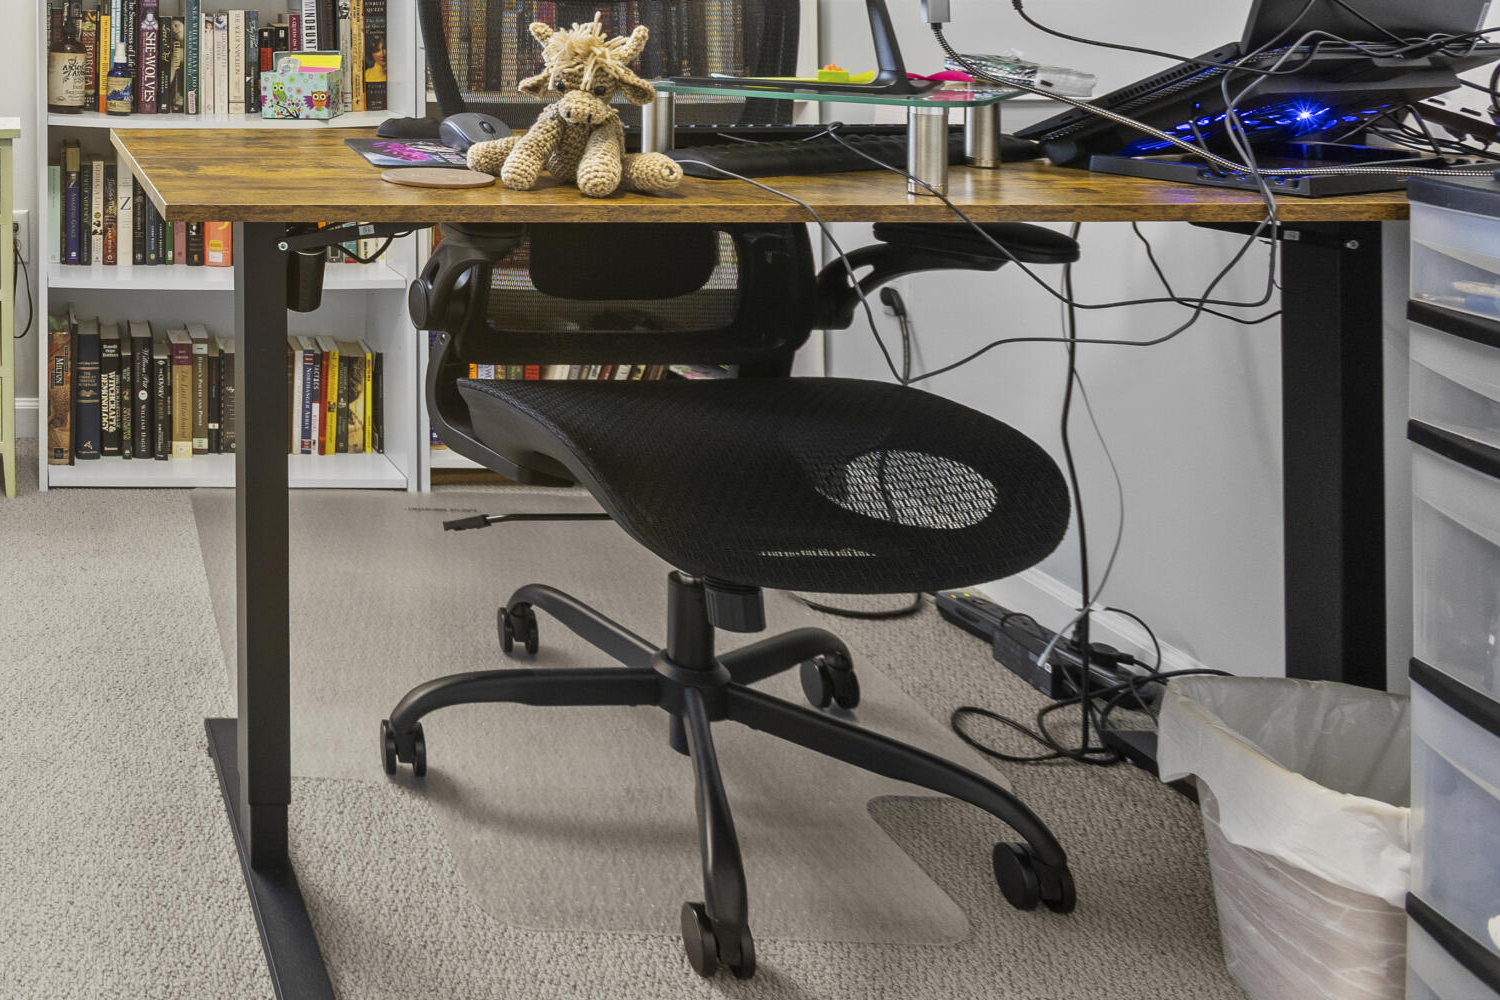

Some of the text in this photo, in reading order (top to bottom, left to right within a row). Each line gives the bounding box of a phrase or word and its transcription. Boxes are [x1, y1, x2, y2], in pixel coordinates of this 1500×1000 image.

[128, 45, 135, 53] of
[292, 39, 297, 47] ON
[85, 45, 93, 86] BORGIA
[144, 32, 156, 102] SHE-WOLVES
[120, 197, 131, 210] Z
[56, 357, 64, 384] MILTON
